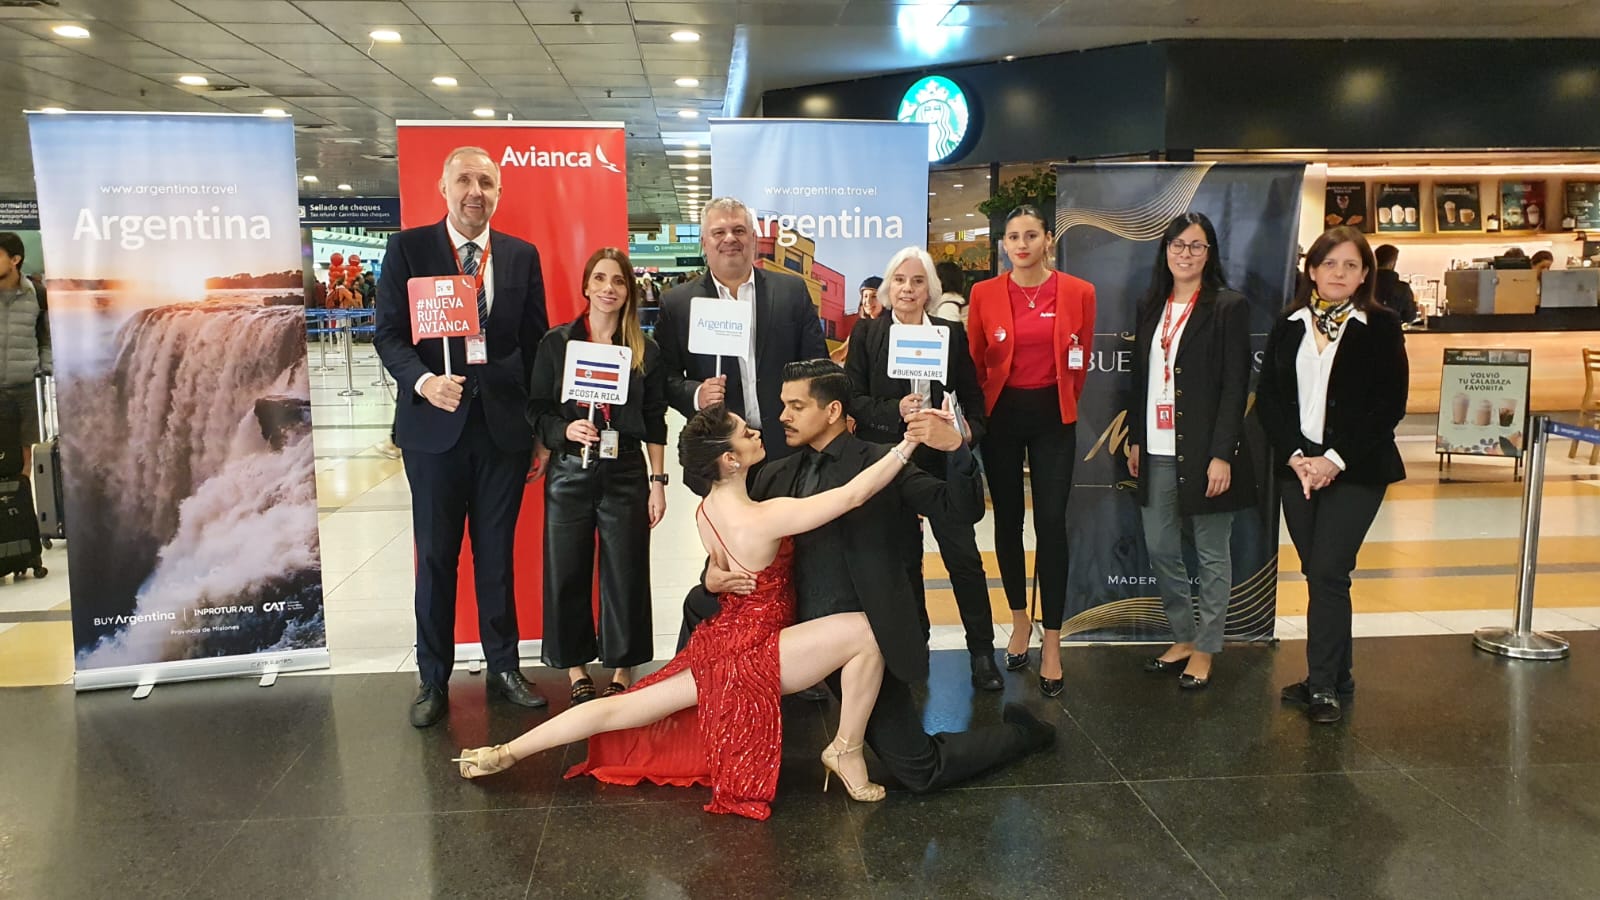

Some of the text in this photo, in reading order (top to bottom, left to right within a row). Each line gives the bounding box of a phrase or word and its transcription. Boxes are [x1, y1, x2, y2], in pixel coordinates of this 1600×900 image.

[500, 146, 592, 168] Avianca
[100, 184, 238, 197] www.argentina.travel
[765, 186, 877, 198] www.argentina.travel
[350, 204, 381, 214] cheques
[72, 206, 272, 250] Argentina
[416, 297, 464, 311] #NUEVA
[417, 310, 447, 322] RUTA
[418, 320, 470, 334] AVIANCA
[697, 317, 743, 331] Argentina
[1087, 351, 1132, 372] BUE
[892, 368, 943, 378] #BUENOS AIRES
[568, 388, 620, 401] #COSTA RICA
[1107, 575, 1157, 585] MADER
[194, 605, 238, 617] INPROTUR
[238, 605, 254, 614] Arg
[262, 601, 286, 613] CAT
[212, 623, 240, 632] Misiones
